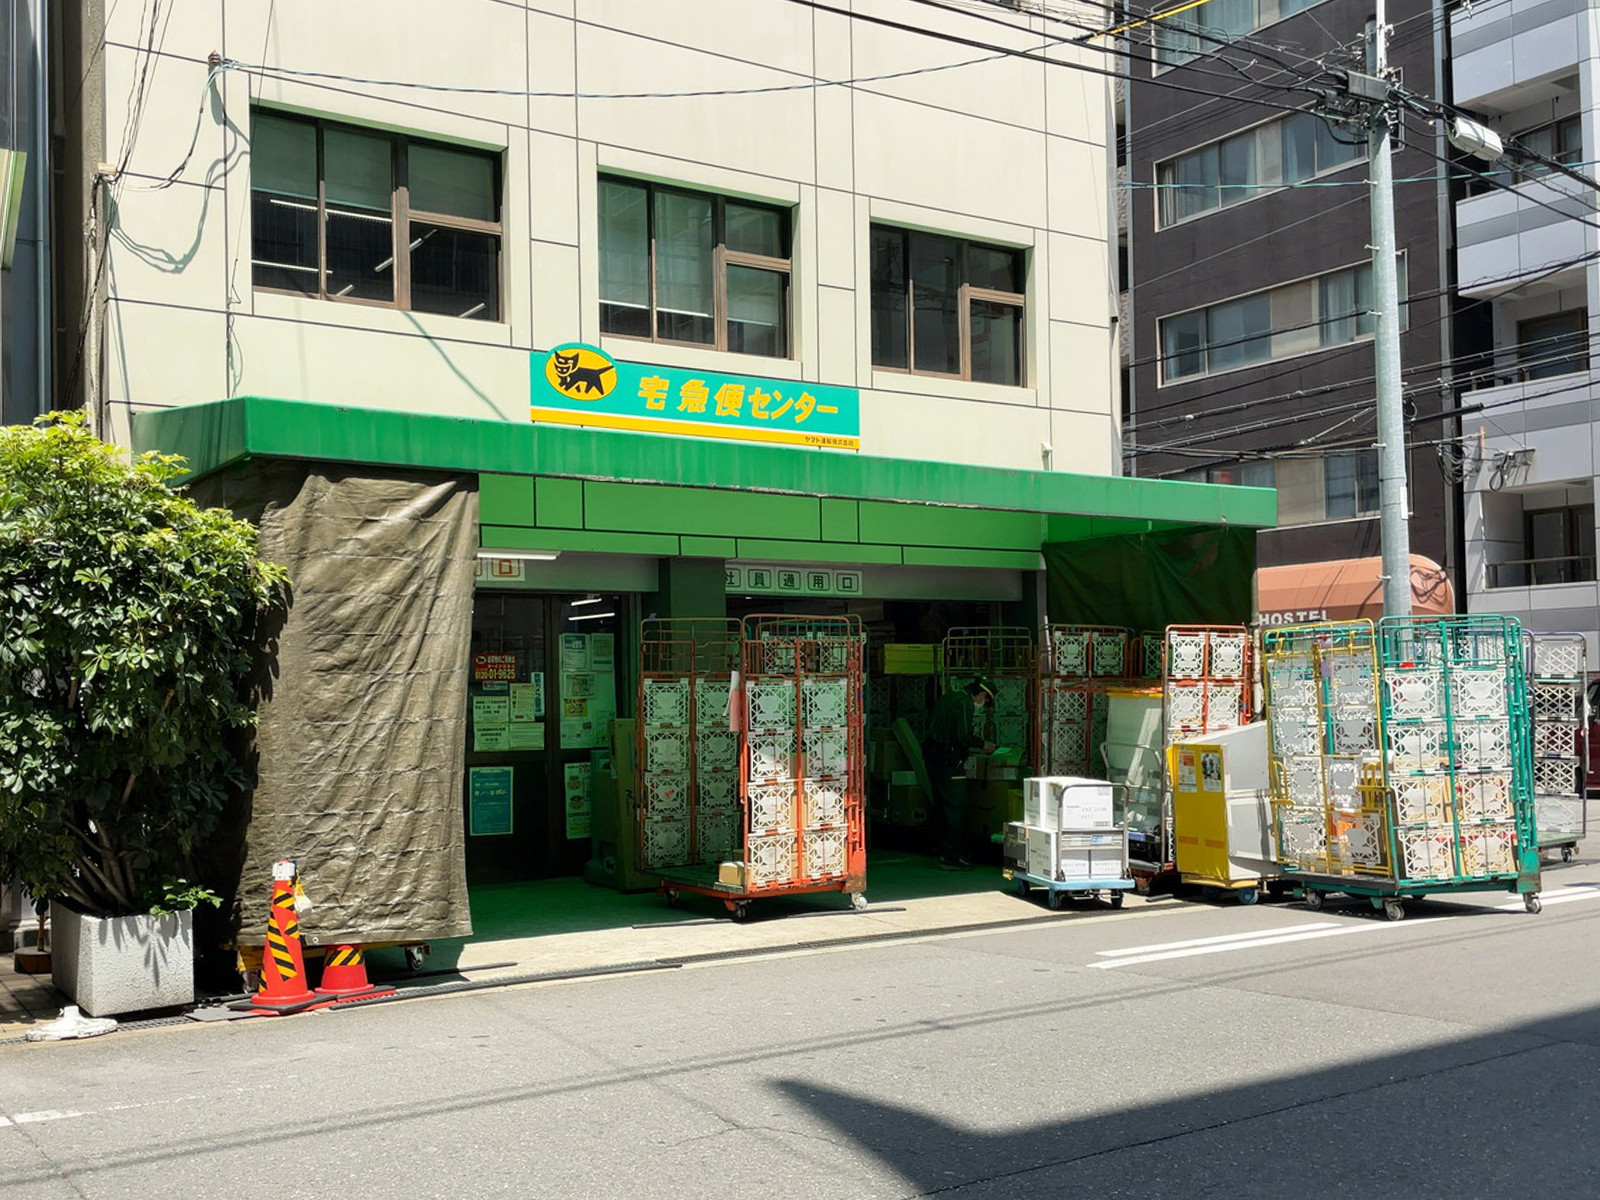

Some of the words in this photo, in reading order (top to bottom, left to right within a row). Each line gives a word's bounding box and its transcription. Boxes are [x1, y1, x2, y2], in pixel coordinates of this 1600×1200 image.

[638, 376, 838, 423] 宅急便センター
[725, 571, 852, 589] 社員通用口
